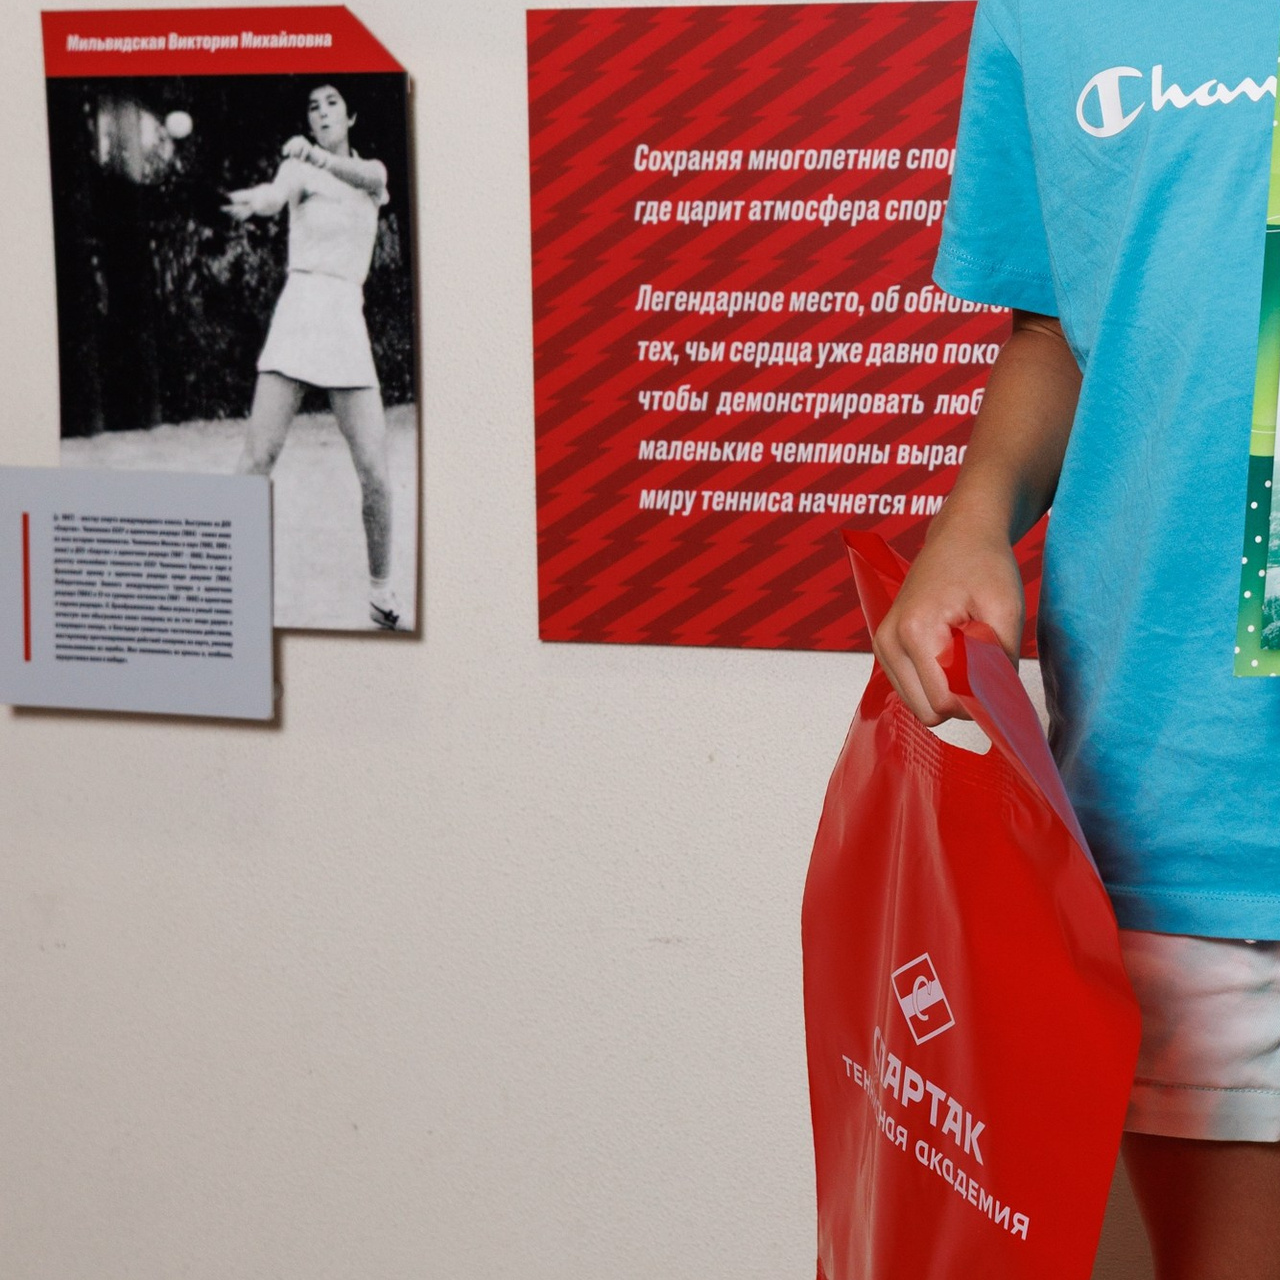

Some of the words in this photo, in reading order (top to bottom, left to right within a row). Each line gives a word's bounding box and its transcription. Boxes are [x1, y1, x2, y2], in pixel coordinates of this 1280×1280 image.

[66, 34, 167, 52] Мильвидская
[167, 32, 239, 52] Виктория
[240, 31, 333, 49] Михайловна
[634, 144, 743, 176] Сохраняя
[748, 148, 901, 171] многолетние
[634, 200, 673, 225] где
[676, 200, 745, 227] царит
[748, 194, 880, 227] атмосфера
[635, 284, 785, 317] Легендарное
[788, 291, 865, 316] место,
[870, 284, 901, 313] об
[637, 340, 679, 365] тех,
[685, 341, 726, 362] чьи
[729, 341, 813, 368] сердца
[815, 342, 864, 369] уже
[865, 342, 939, 367] давно
[638, 384, 709, 412] чтобы
[716, 391, 924, 419] демонстрировать
[638, 440, 764, 462] маленькие
[770, 442, 891, 465] чемпионы
[639, 489, 697, 516] миру
[701, 490, 794, 513] тенниса
[798, 492, 906, 515] начнется
